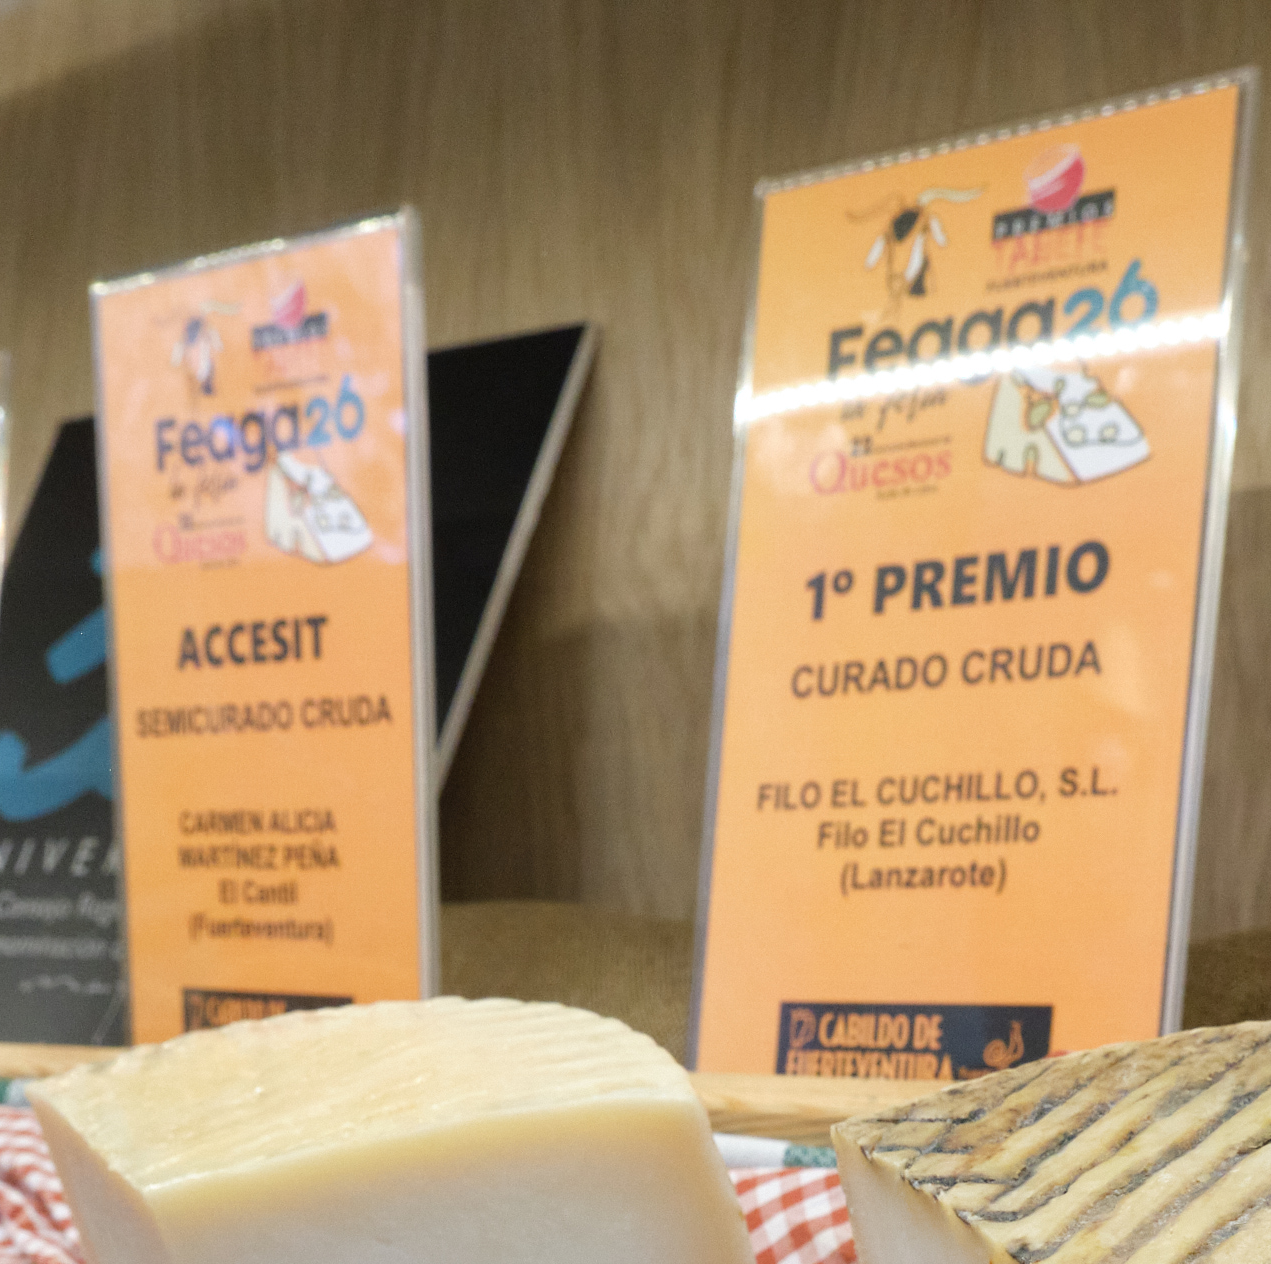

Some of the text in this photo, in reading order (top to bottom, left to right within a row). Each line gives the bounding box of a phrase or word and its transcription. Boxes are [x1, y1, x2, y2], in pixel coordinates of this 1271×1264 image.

[154, 374, 365, 474] Feaga26
[872, 540, 1111, 614] PREMIO
[178, 616, 328, 668] ACCESIT
[791, 640, 1102, 699] CURADO CRUDA
[137, 695, 393, 739] SEMICURADO CRUDA
[756, 780, 822, 811] FILO
[830, 778, 867, 808] EL
[1058, 765, 1120, 799] S.L.
[817, 821, 870, 850] Filo
[916, 812, 1042, 847] Cuchillo
[840, 857, 1009, 897] (Lanzarote)
[818, 1012, 944, 1050] CABILDO DE
